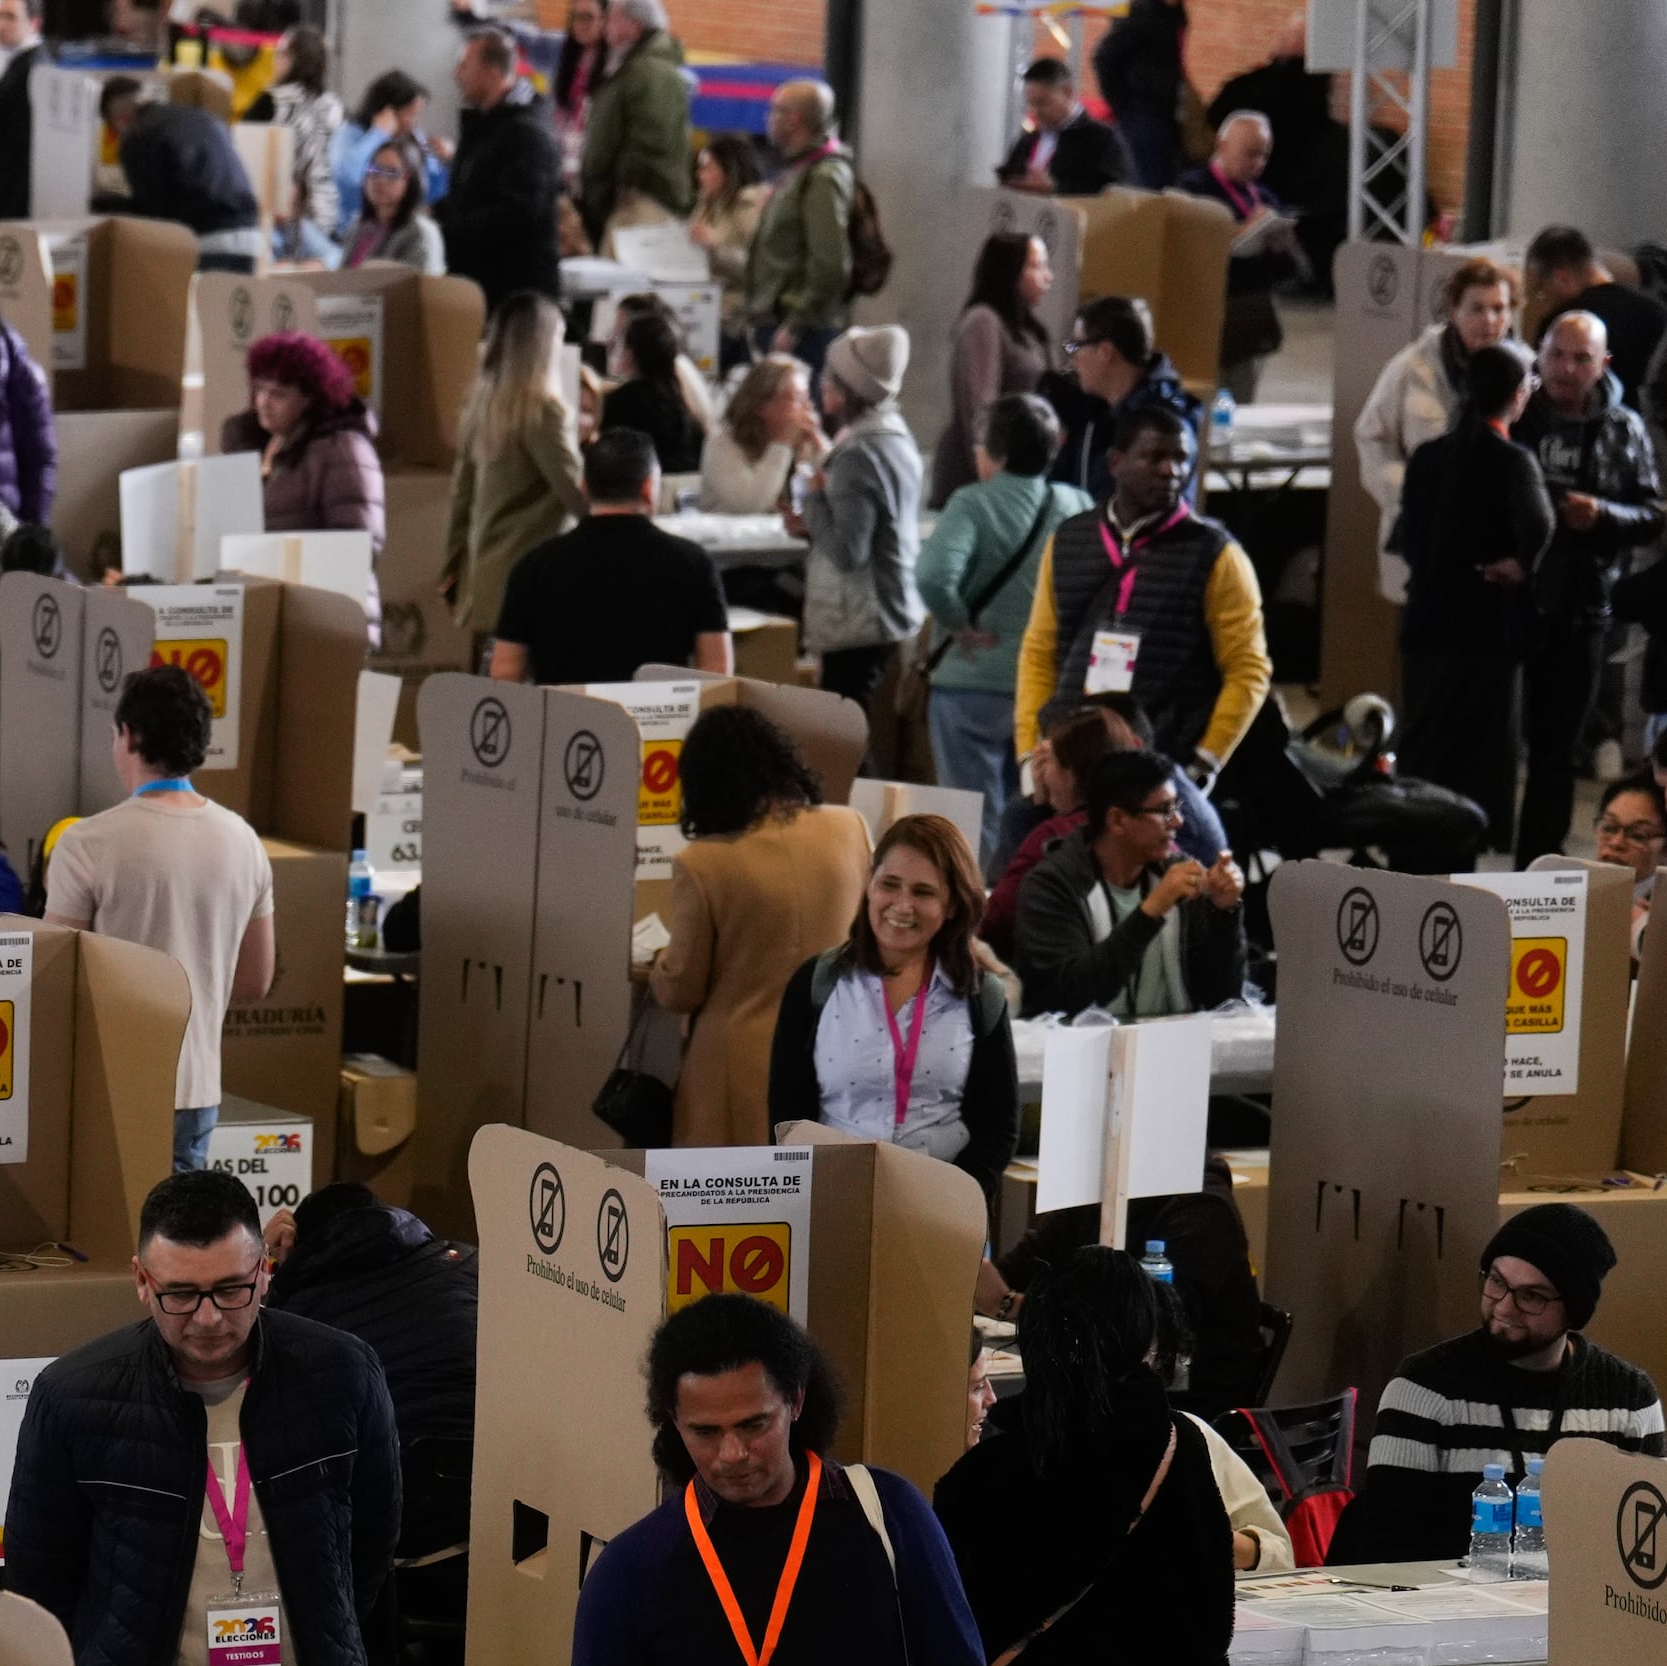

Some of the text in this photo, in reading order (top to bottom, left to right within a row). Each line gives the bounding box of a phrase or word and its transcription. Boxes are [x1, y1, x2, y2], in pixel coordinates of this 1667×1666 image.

[661, 1176, 800, 1189] EN LA CONSULTA DE
[677, 1236, 784, 1294] NO
[526, 1255, 626, 1312] Prohibido el uso de celular
[1605, 1584, 1667, 1624] Prohibido
[213, 1617, 275, 1636] 2026
[216, 1633, 275, 1643] ELECCIONES
[226, 1651, 264, 1660] TESTIGOS
